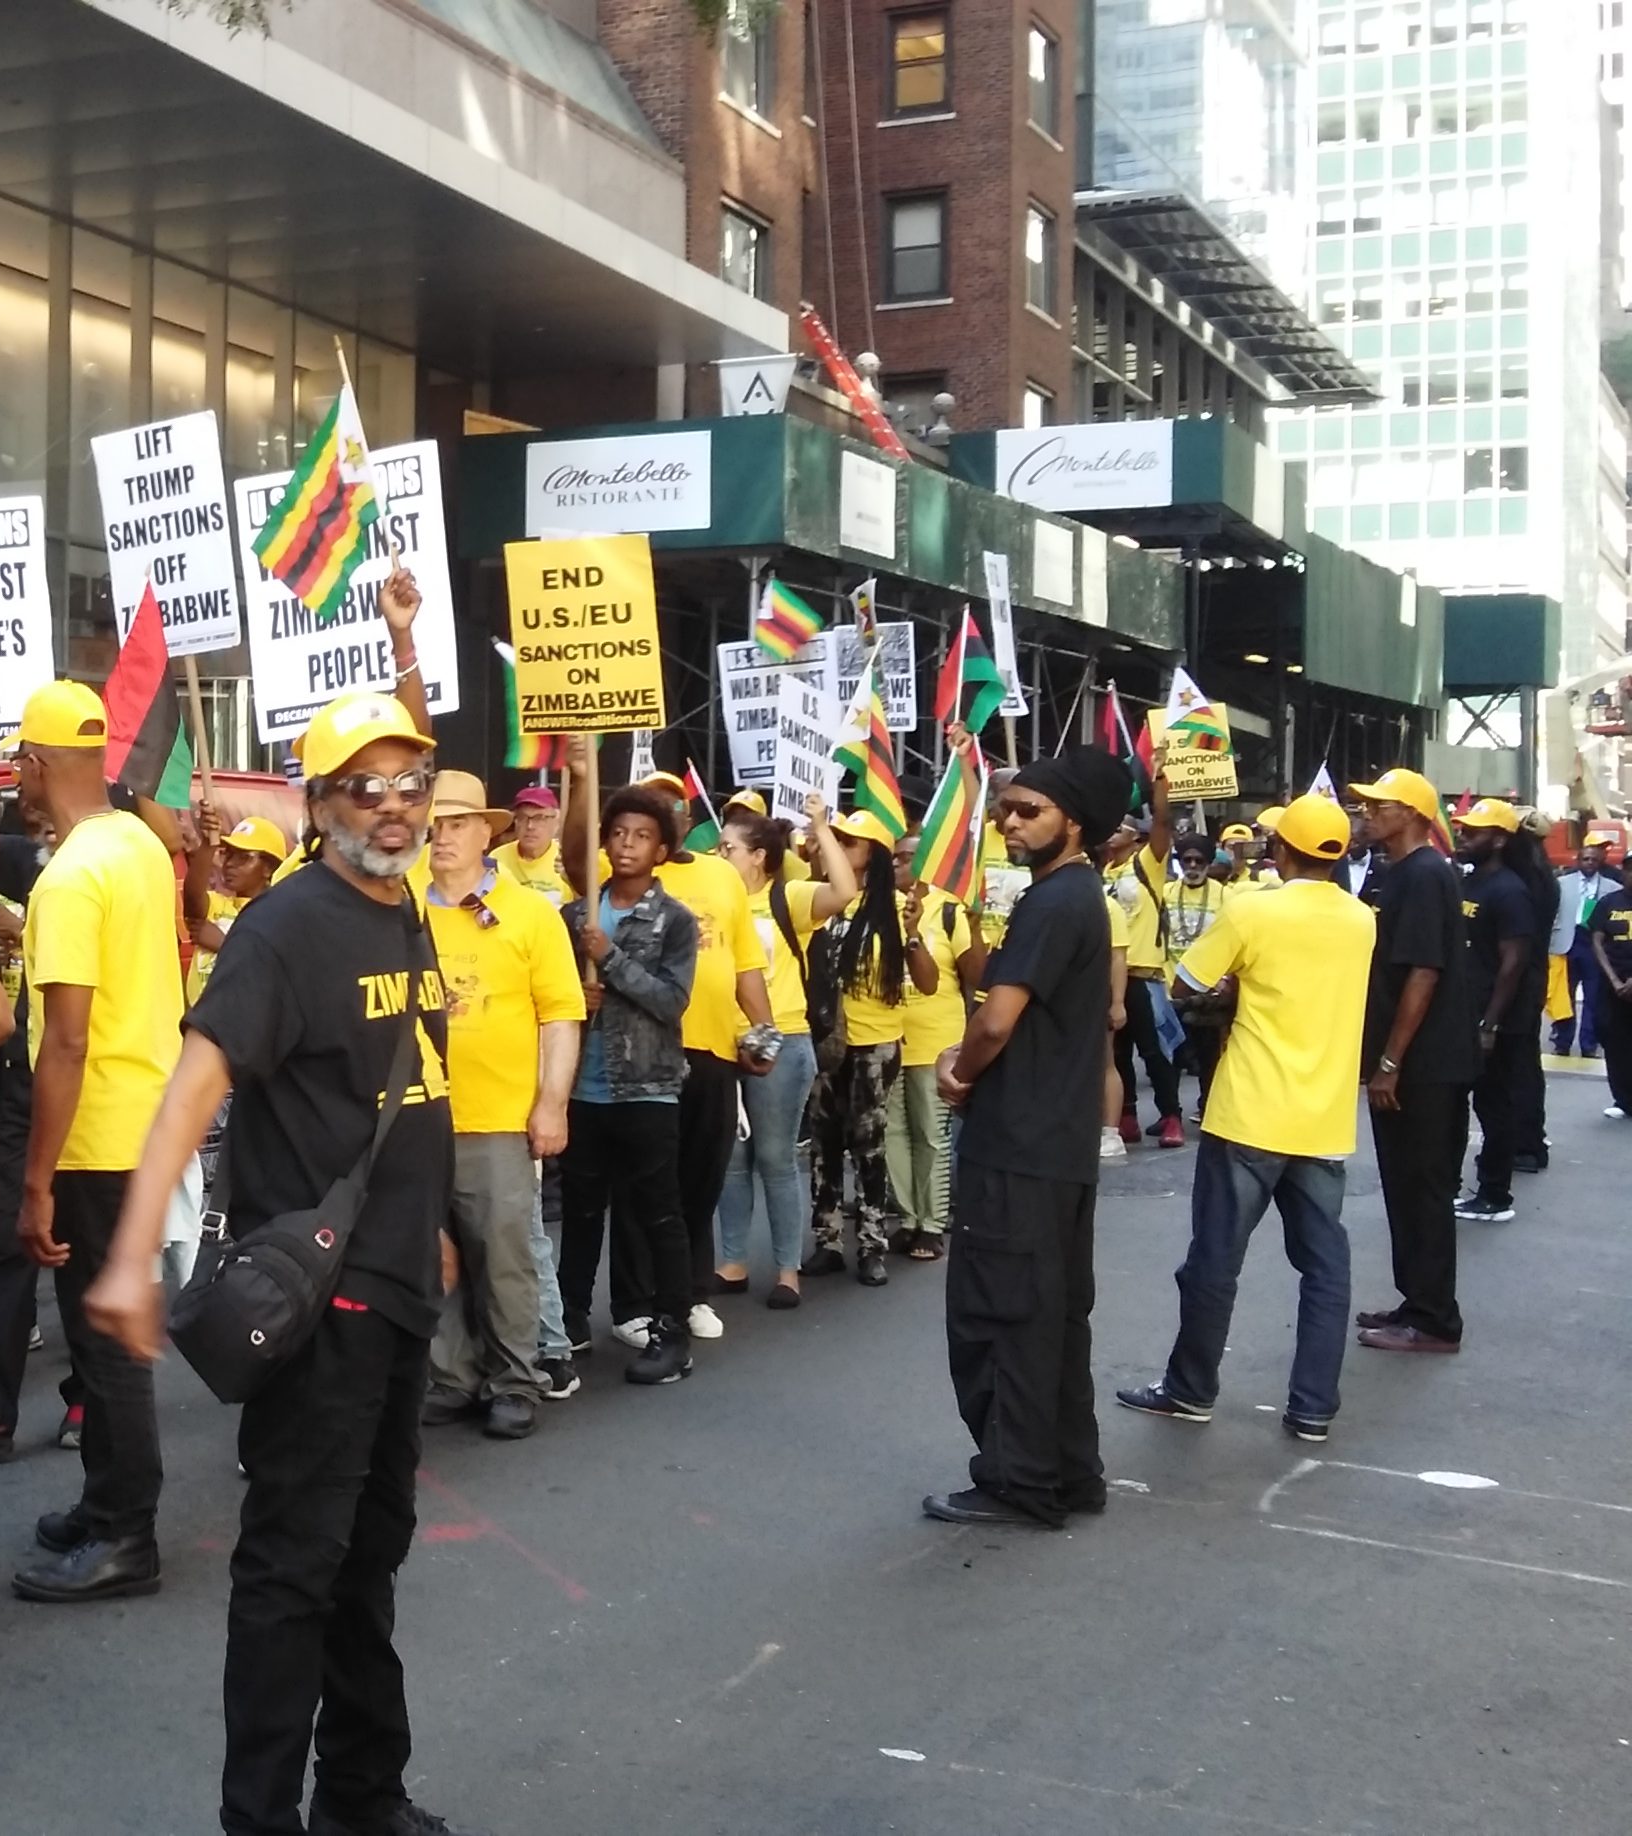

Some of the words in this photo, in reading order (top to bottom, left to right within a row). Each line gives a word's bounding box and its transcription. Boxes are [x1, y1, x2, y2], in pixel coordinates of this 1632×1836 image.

[134, 425, 173, 460] LIFT
[124, 465, 195, 505] TRUMP
[543, 460, 692, 494] Montebello
[556, 487, 684, 507] RISTORANTE
[109, 502, 224, 551] SANCTIONS
[153, 552, 188, 587] OFF
[542, 566, 604, 590] END
[522, 602, 632, 629] U.S./EU
[519, 639, 652, 663] SANCTIONS
[307, 640, 390, 693] PEOPLE
[567, 667, 601, 686] ON
[522, 688, 657, 712] ZIMBABWE
[730, 676, 762, 700] WAR
[524, 712, 659, 730] ANSWERcoalition.org
[791, 754, 811, 785] KILL
[1164, 753, 1229, 766] ANCTIONS
[1187, 767, 1205, 775] ON
[1168, 776, 1234, 790] IMBABWE
